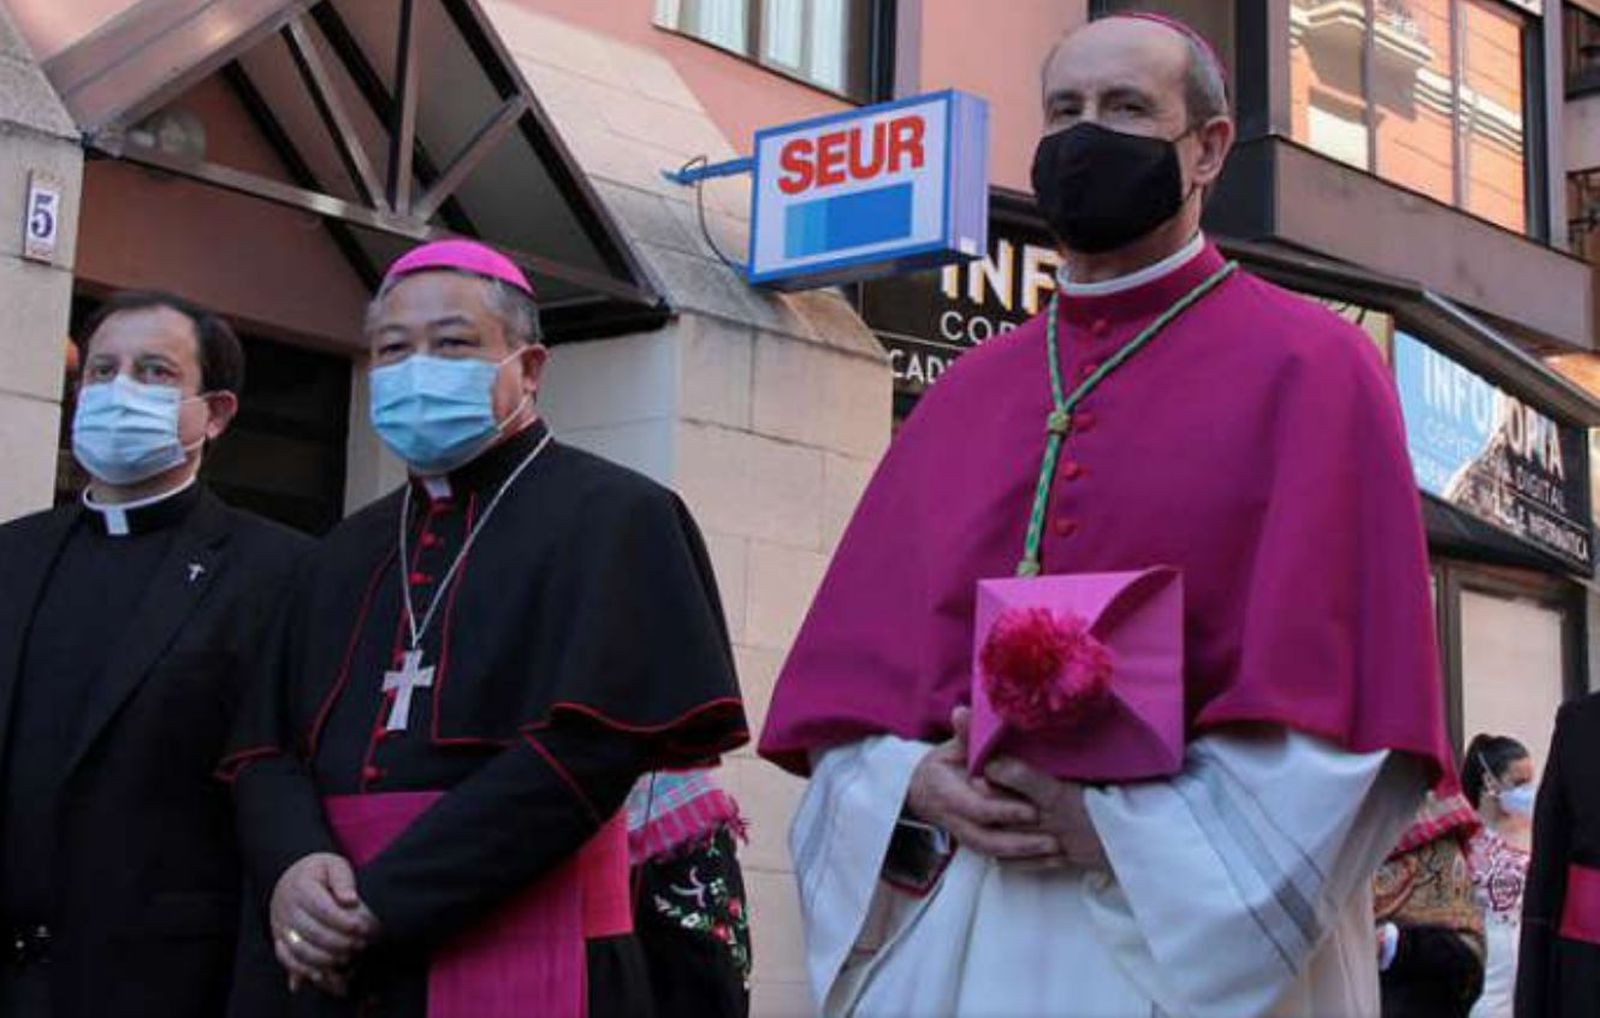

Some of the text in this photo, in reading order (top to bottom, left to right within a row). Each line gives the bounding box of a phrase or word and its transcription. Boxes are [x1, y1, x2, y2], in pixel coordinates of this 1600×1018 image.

[777, 115, 925, 194] SEUR
[31, 193, 53, 238] 5
[890, 349, 954, 384] CAD
